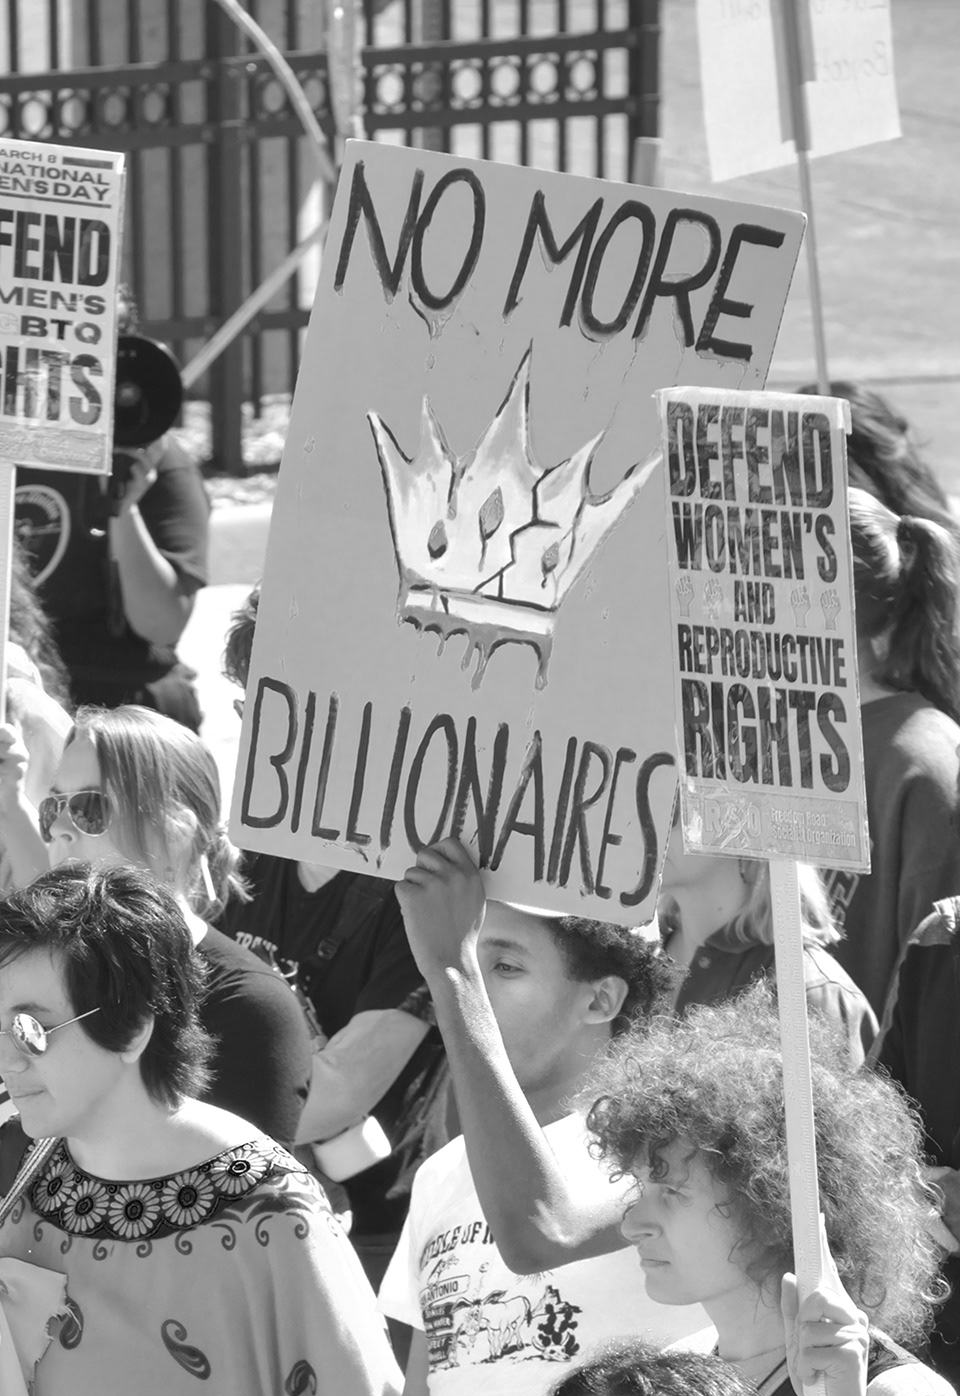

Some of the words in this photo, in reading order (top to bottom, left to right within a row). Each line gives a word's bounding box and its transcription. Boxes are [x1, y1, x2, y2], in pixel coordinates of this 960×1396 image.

[47, 155, 56, 163] 8
[53, 183, 110, 201] DAY
[334, 160, 486, 310] NO
[502, 190, 786, 363] MORE
[667, 401, 834, 509] DEFEND
[672, 502, 838, 583] WOMEN'S
[734, 580, 775, 625] AND
[678, 624, 847, 687] REPRODUCTIVE
[682, 678, 851, 793] RIGHTS
[241, 677, 676, 906] BILLIONAIRES
[772, 808, 804, 825] Freedom
[806, 829, 856, 847] Organization
